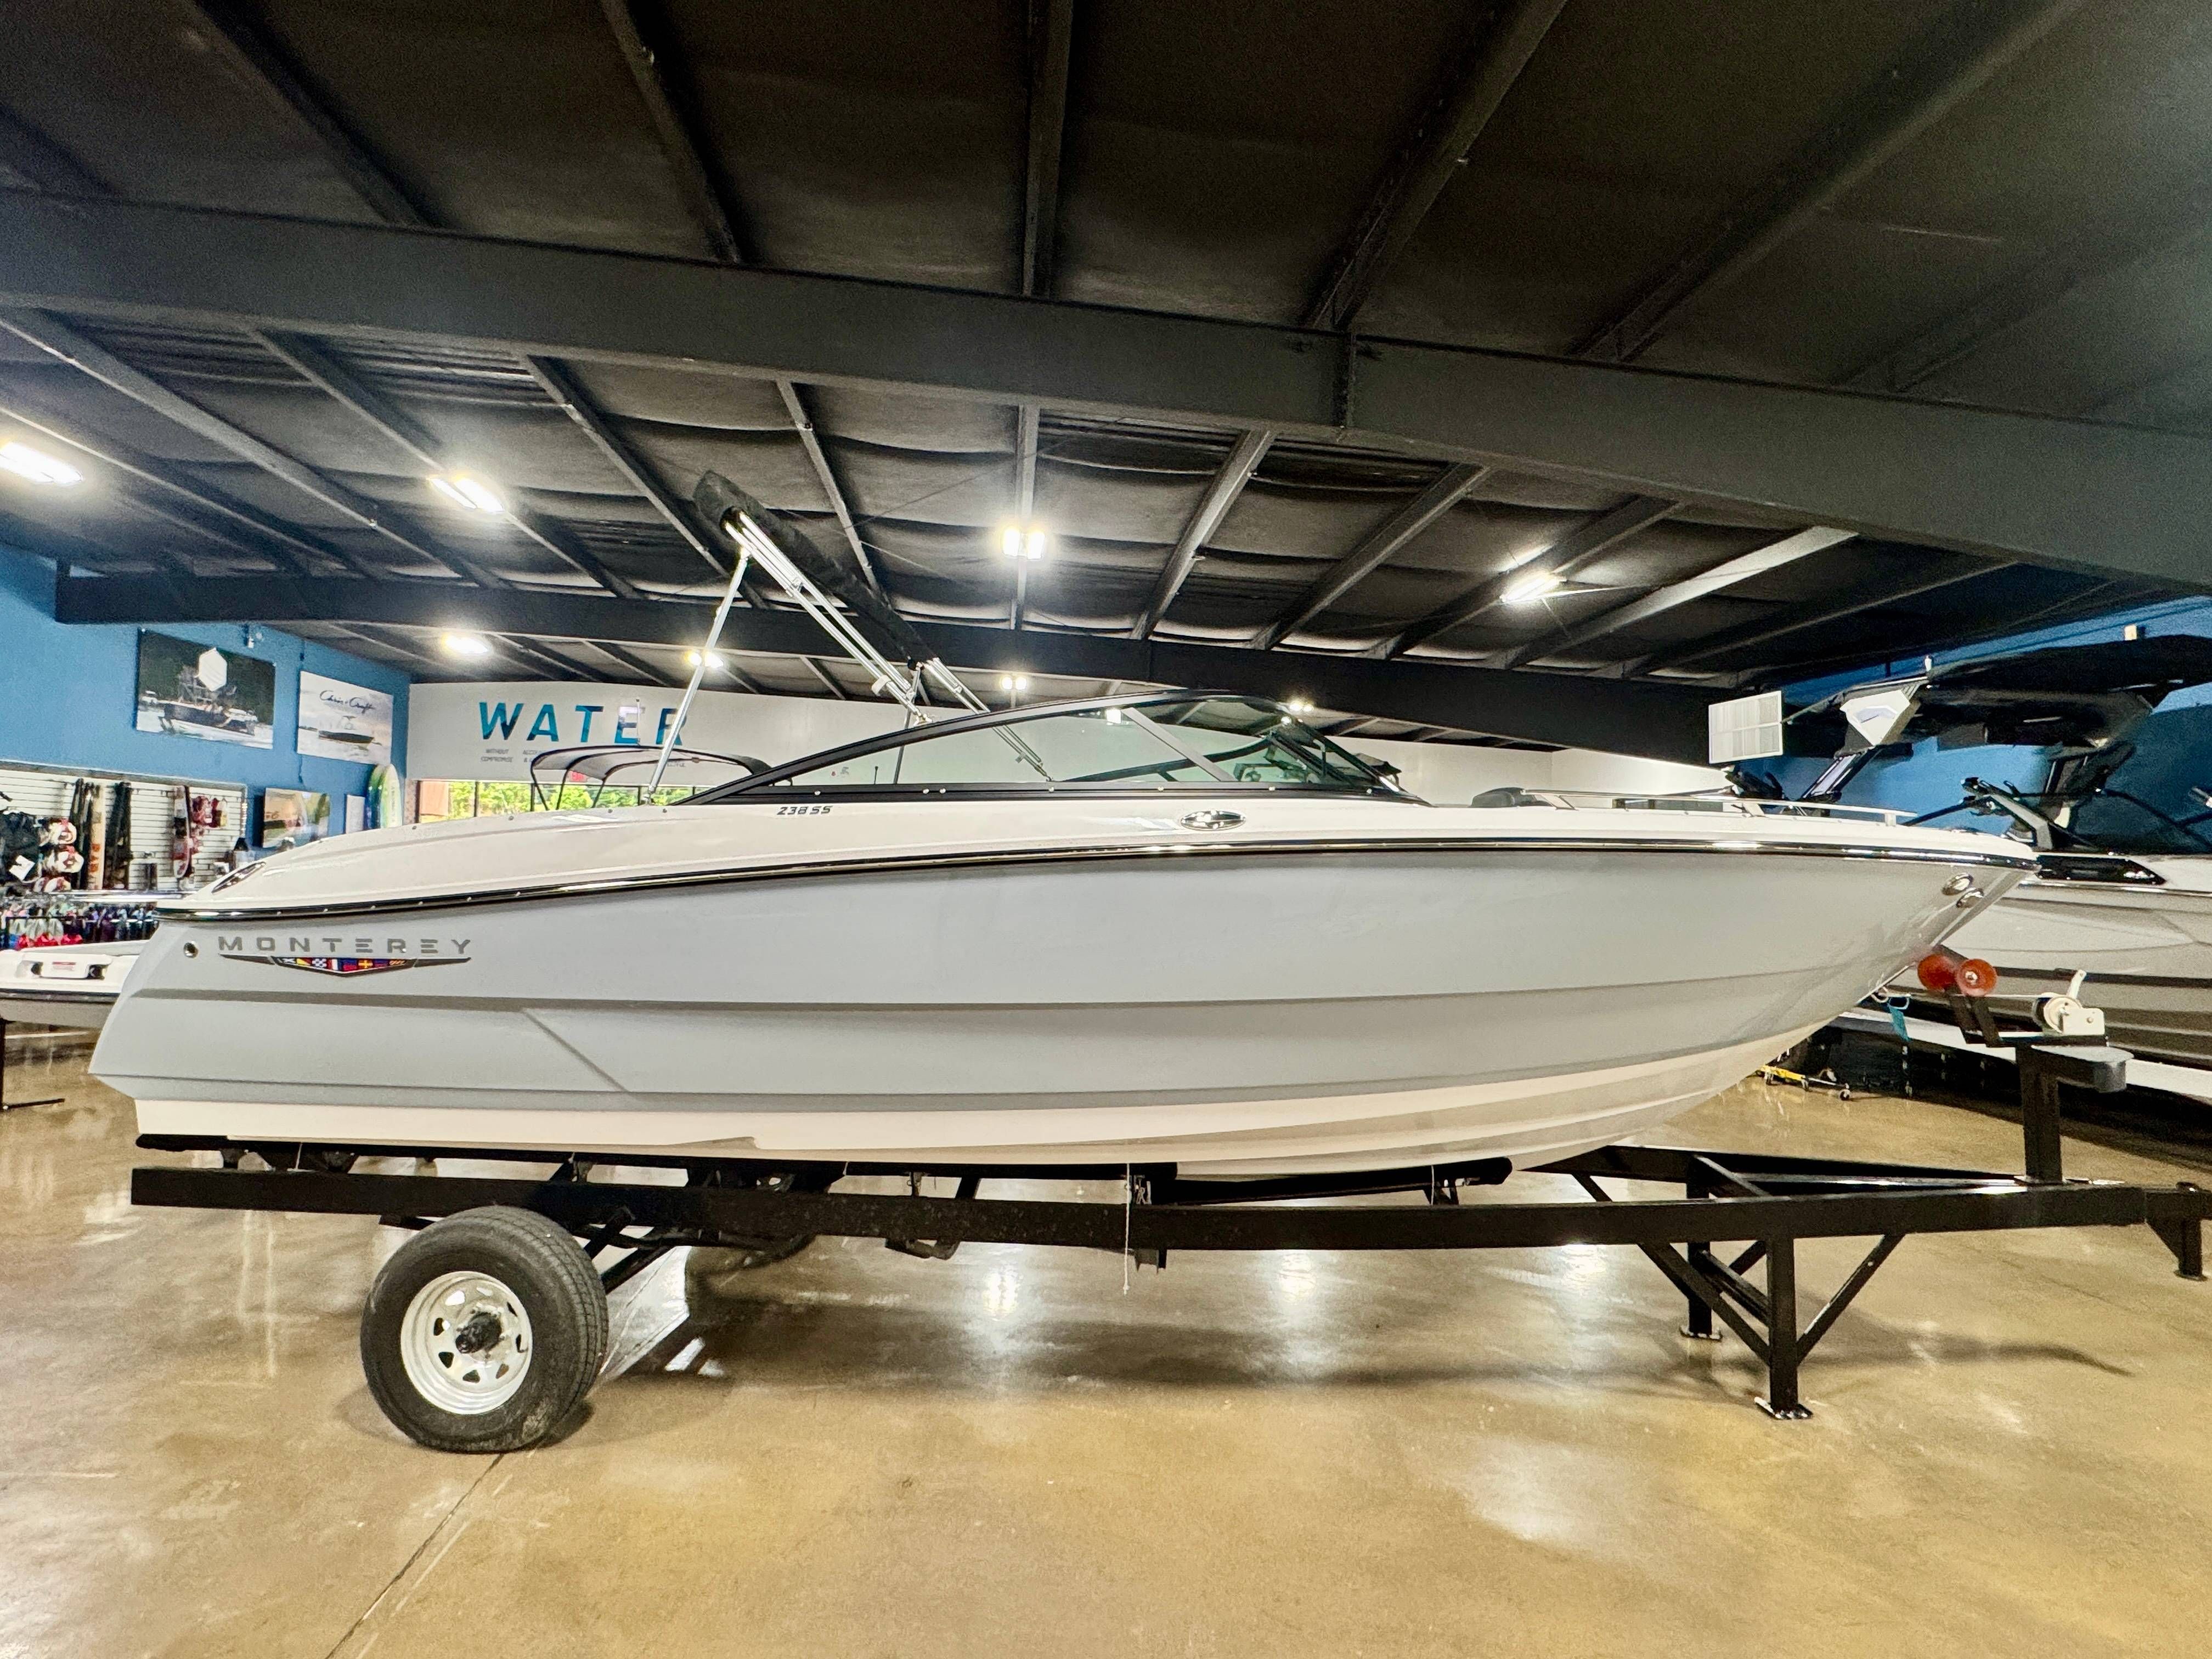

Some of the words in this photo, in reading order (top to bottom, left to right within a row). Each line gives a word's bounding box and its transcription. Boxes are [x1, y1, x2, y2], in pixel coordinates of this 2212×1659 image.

[479, 702, 687, 746] WATER
[777, 806, 809, 815] 238
[809, 805, 833, 815] SS
[218, 936, 471, 955] MONTEREY
